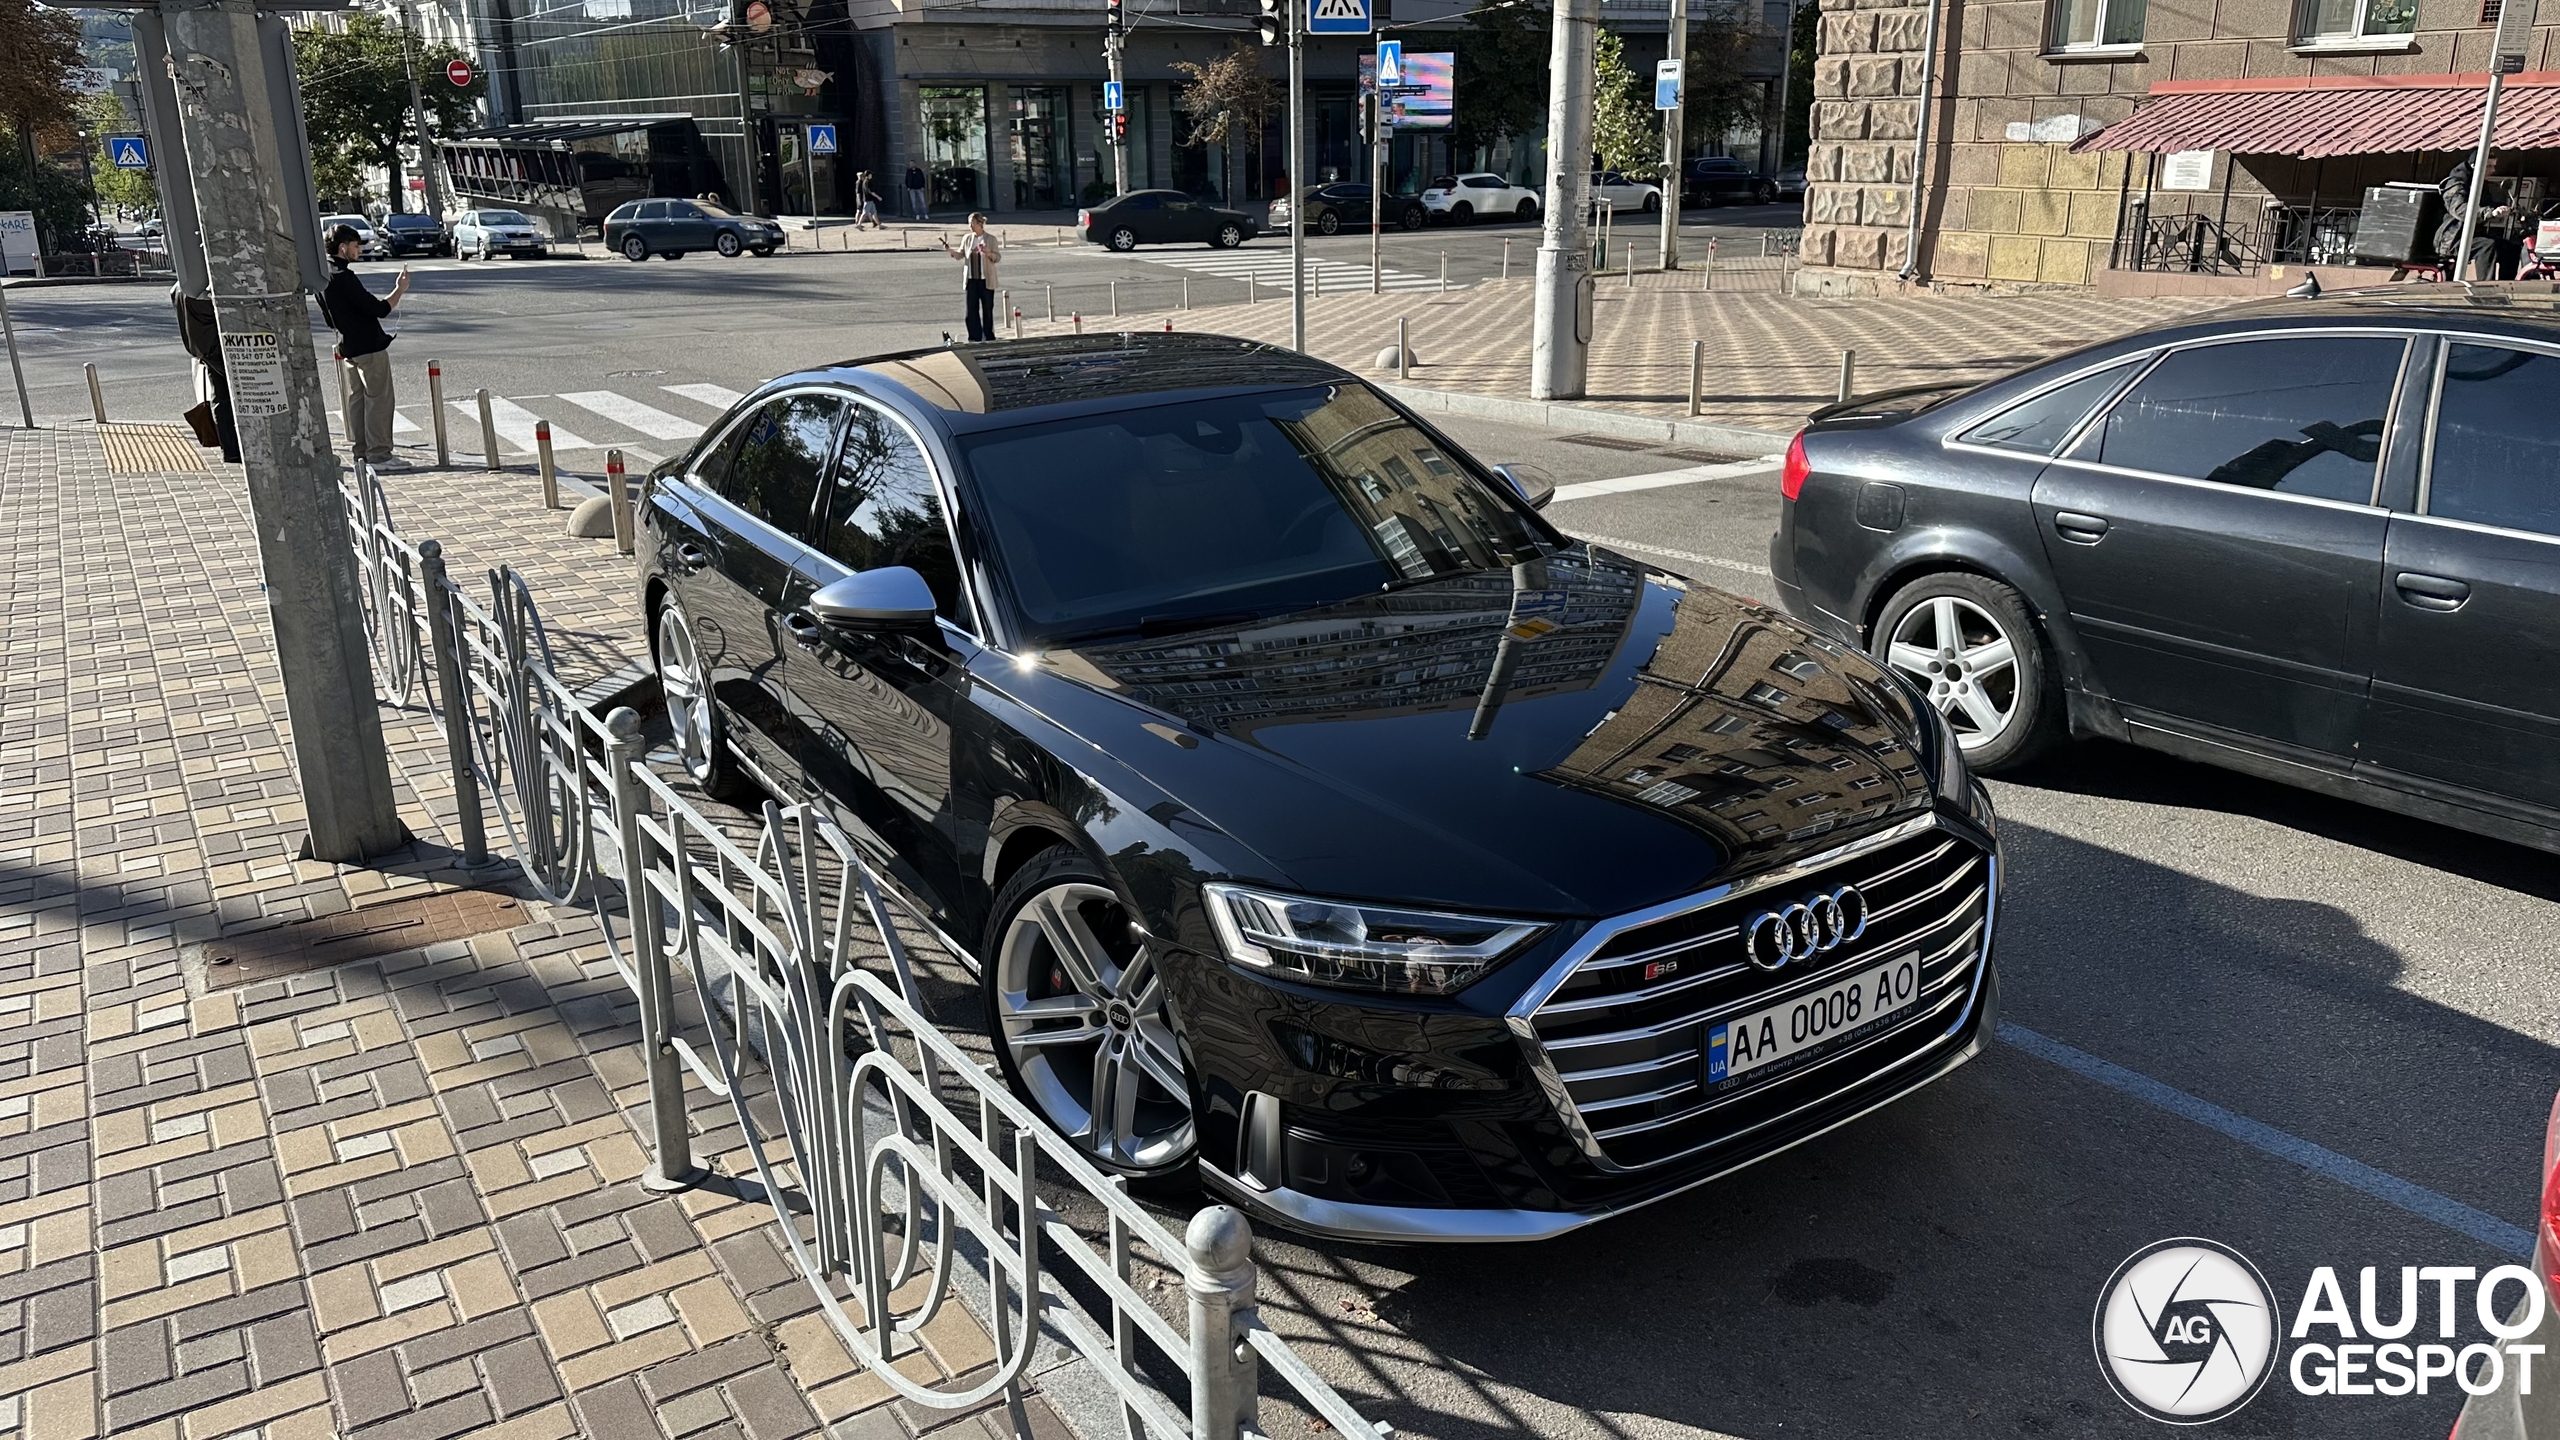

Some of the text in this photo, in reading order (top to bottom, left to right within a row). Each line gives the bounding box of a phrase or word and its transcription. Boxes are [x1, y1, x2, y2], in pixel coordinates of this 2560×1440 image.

[223, 334, 276, 347] ЖИТЛО
[238, 405, 250, 414] 067
[252, 405, 262, 414] 381
[265, 404, 275, 413] 79
[1731, 962, 1914, 1068] AA 0008 AO
[1747, 1067, 1766, 1080] Audi
[1767, 1058, 1793, 1073] Центр
[1794, 1050, 1812, 1062] Київ
[1838, 1032, 1853, 1044] +38
[1854, 1025, 1874, 1039] (044)
[1875, 1018, 1889, 1029] 536
[1892, 1012, 1902, 1022] 92
[1904, 1006, 1912, 1016] 92
[1711, 1059, 1726, 1075] UA
